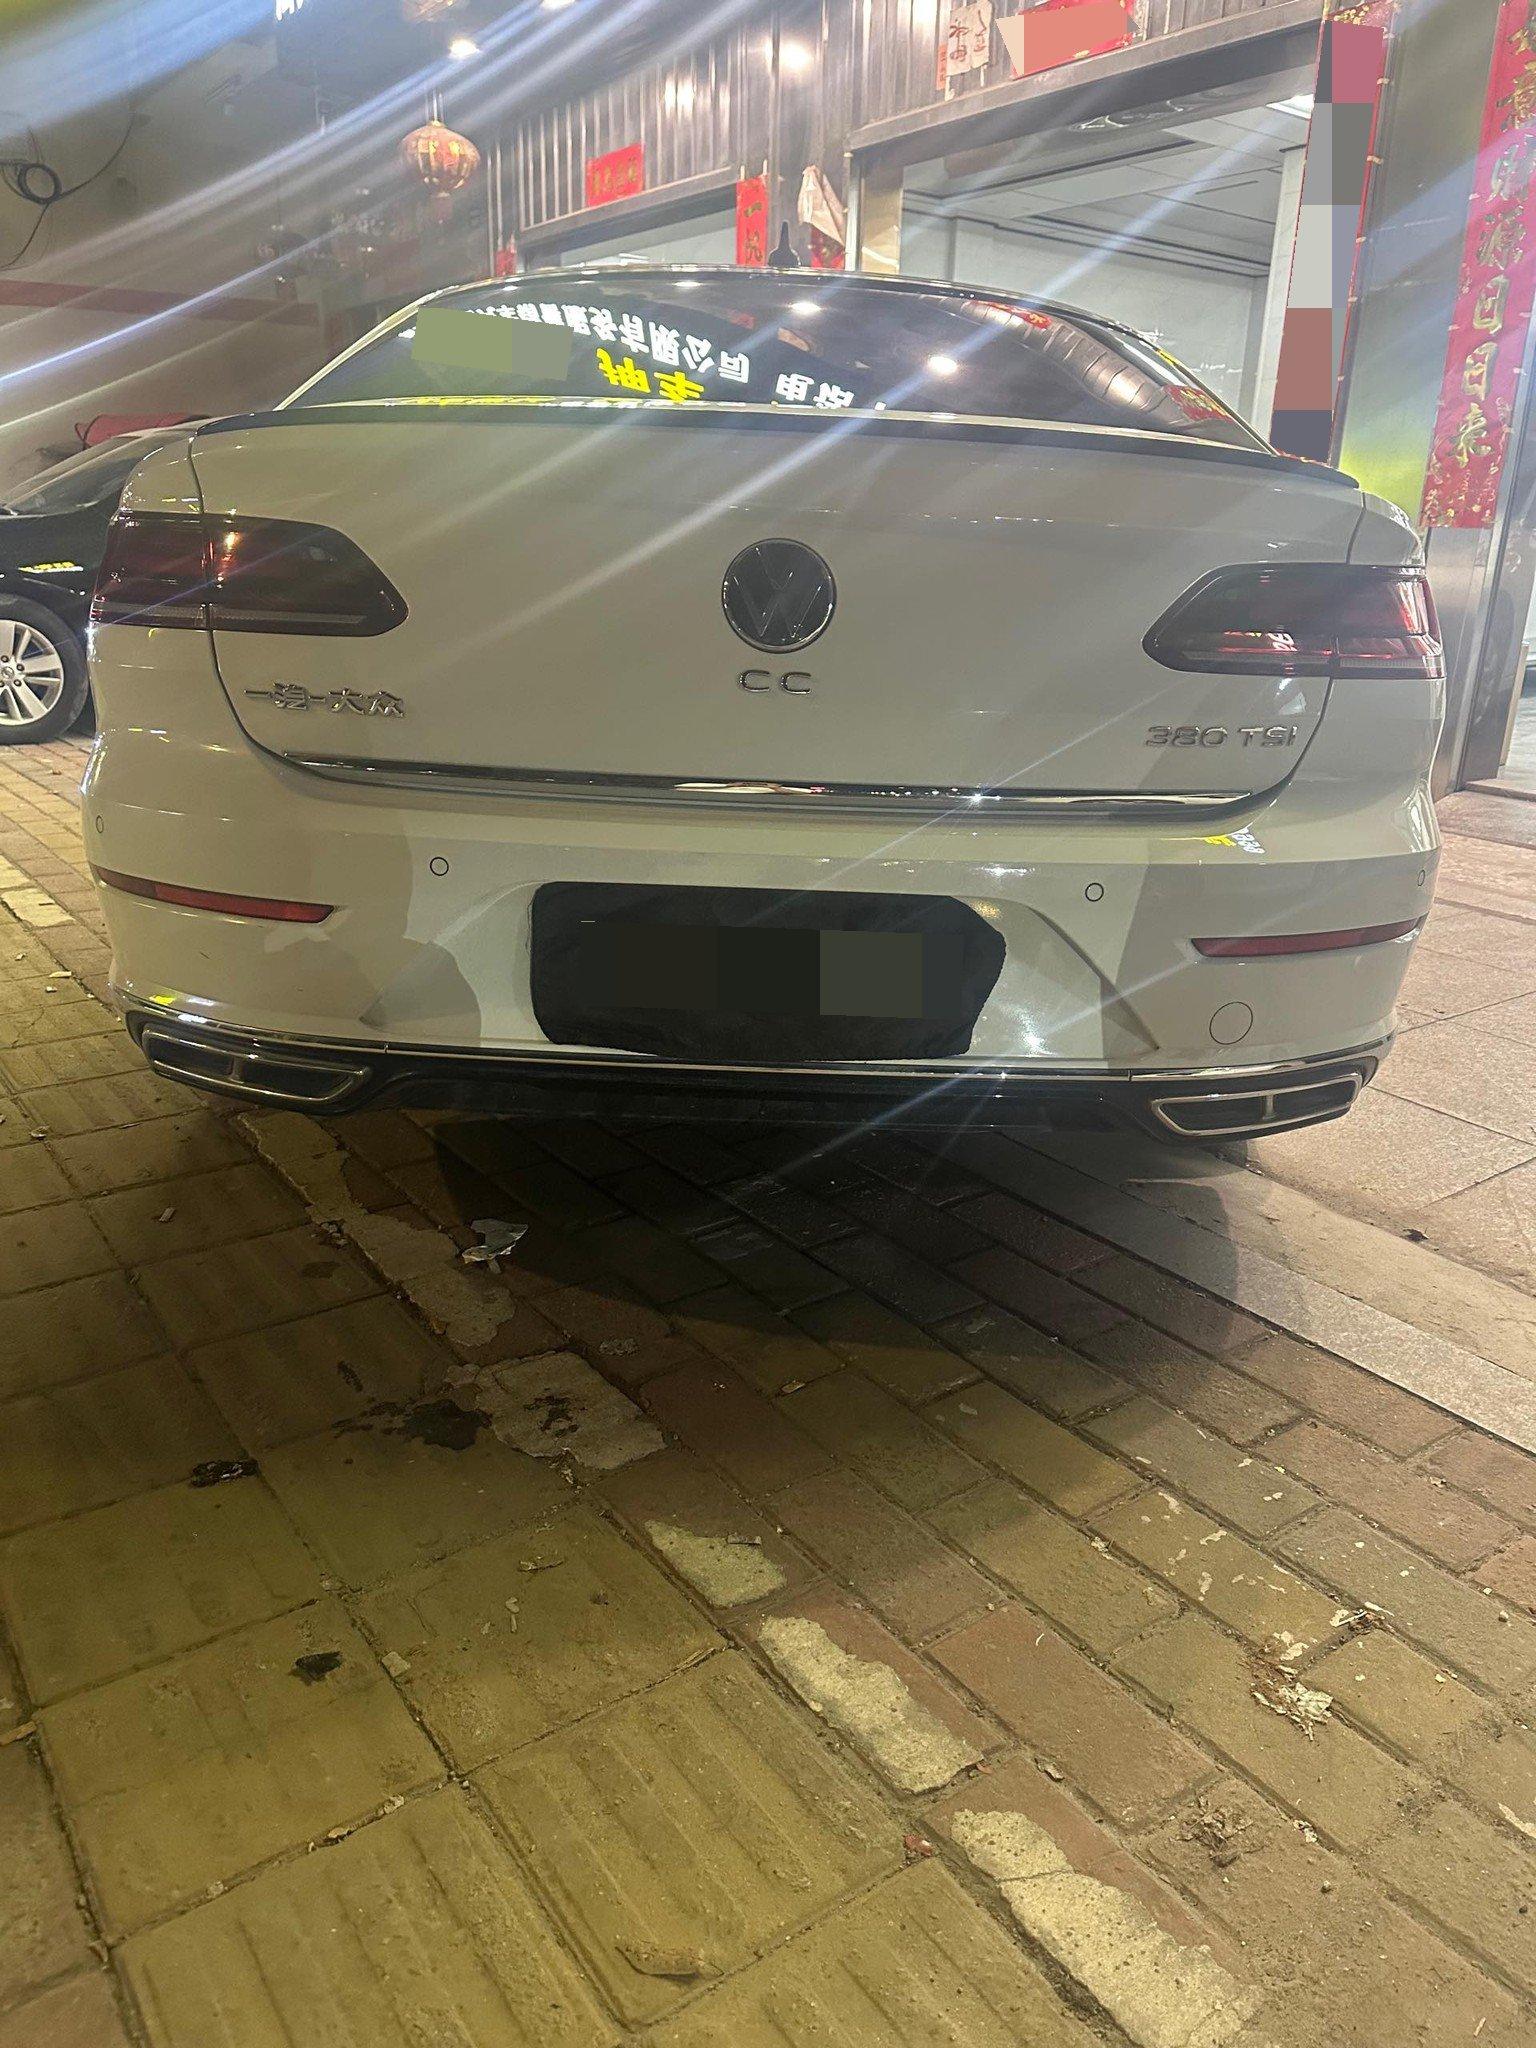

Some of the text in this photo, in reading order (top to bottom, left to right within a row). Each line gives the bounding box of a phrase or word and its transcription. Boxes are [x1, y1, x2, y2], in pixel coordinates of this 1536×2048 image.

[739, 669, 812, 695] CC
[1145, 725, 1299, 747] 380 TSI
